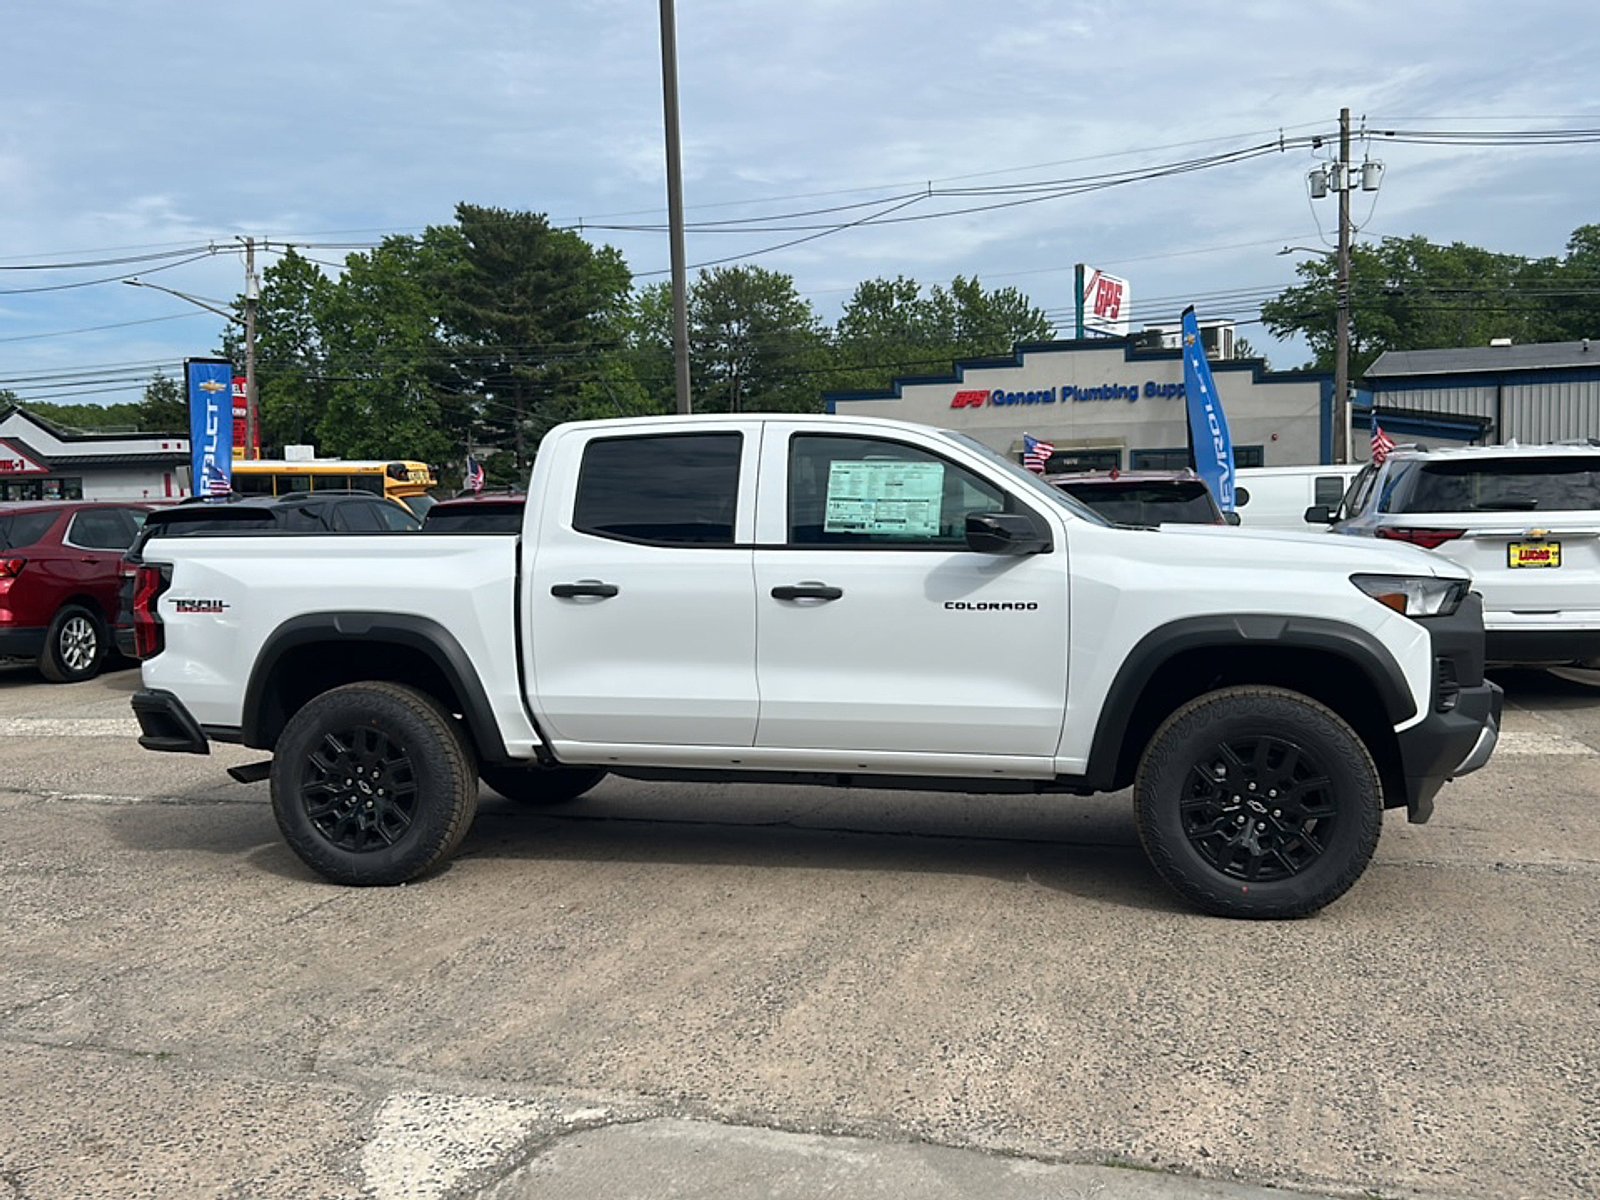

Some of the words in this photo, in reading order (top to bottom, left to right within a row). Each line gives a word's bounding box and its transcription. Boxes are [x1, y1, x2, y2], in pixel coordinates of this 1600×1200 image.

[1094, 278, 1123, 320] GPS
[992, 387, 1056, 406] General
[1061, 383, 1139, 403] Plumbing
[1519, 549, 1551, 561] LUCAS
[944, 601, 1039, 611] COLORADO
